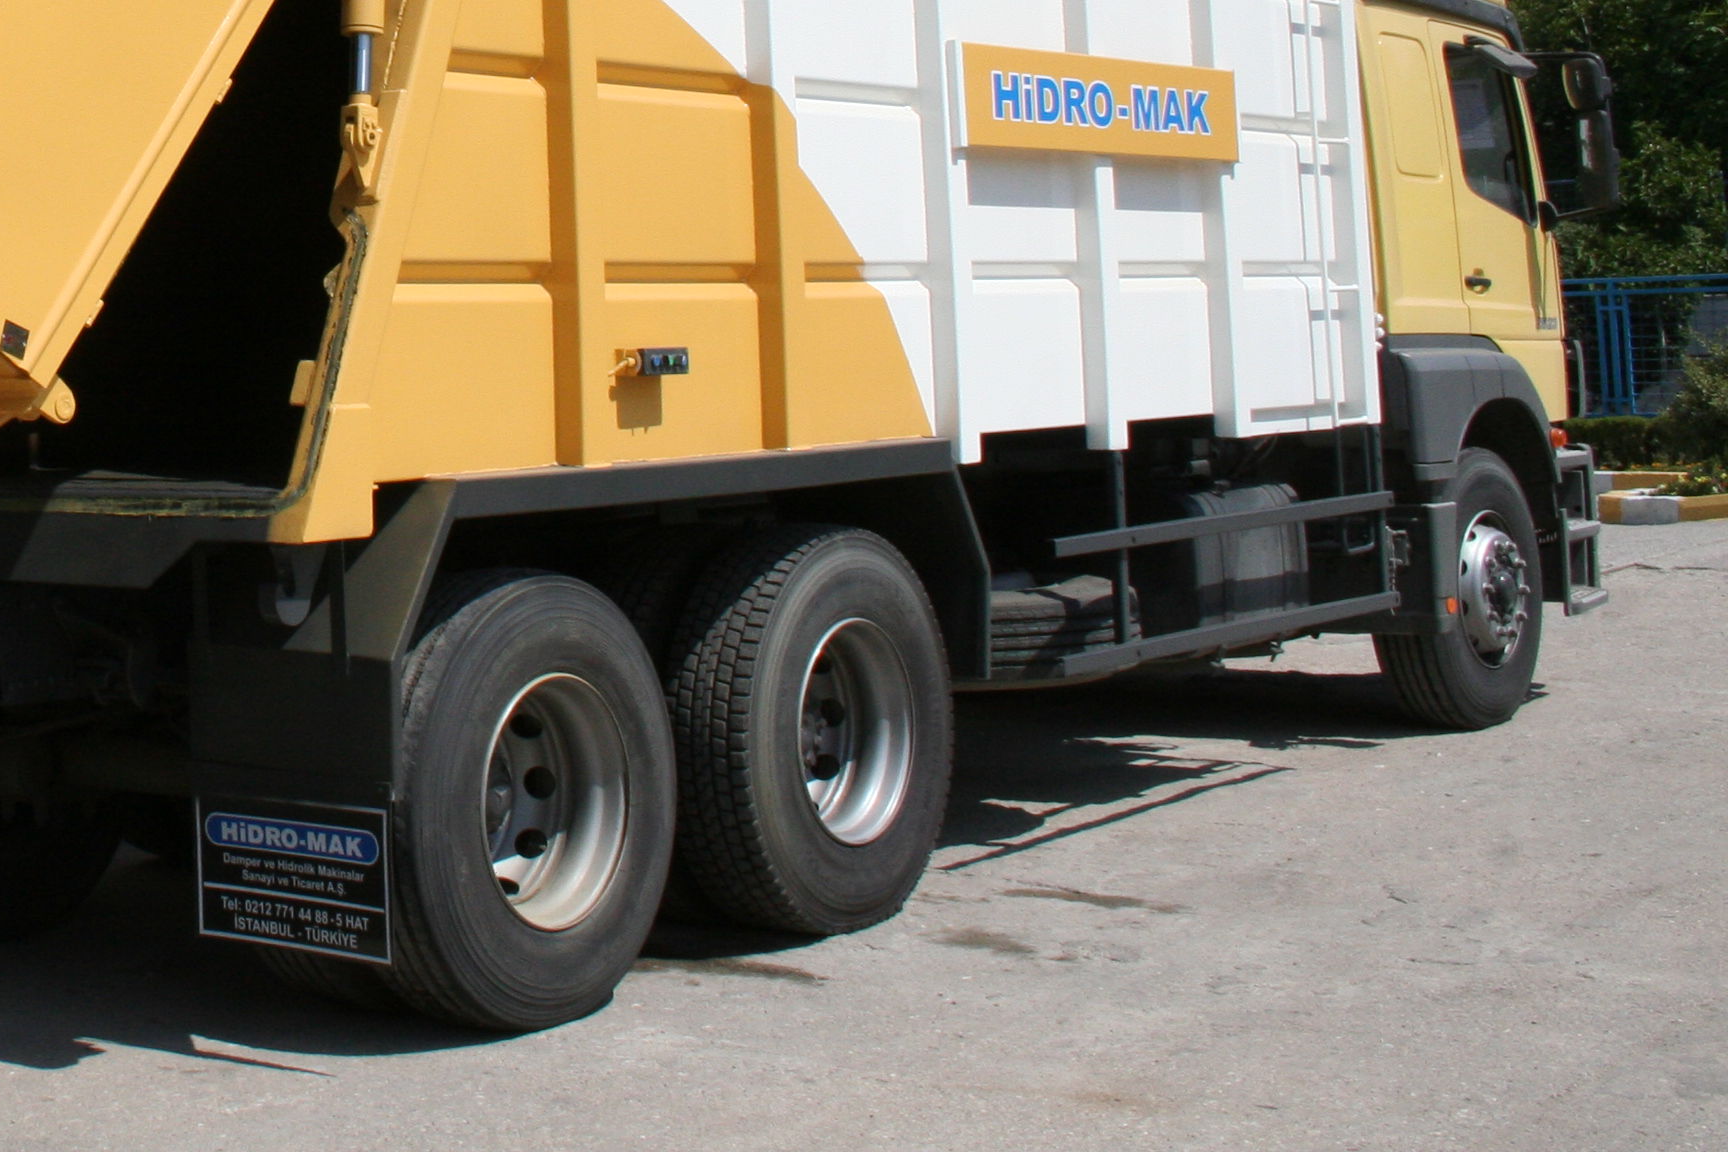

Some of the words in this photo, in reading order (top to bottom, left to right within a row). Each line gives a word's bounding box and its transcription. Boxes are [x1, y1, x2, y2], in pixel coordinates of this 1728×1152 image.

[992, 70, 1211, 135] HiDRO-MAK
[220, 820, 364, 858] HiDRO-MAK
[222, 852, 261, 868] Damper
[263, 859, 276, 870] ve
[277, 859, 315, 874] Hidrolik
[317, 865, 365, 882] Makinalar
[241, 869, 275, 886] Sanayi
[276, 876, 289, 886] ve
[291, 876, 325, 892] Ticaret
[326, 881, 348, 897] A.Ş.
[220, 895, 242, 910] Tel:
[244, 899, 273, 916] 0212
[274, 903, 295, 919] 771
[298, 907, 312, 922] 44
[345, 914, 369, 932] HAT
[233, 912, 295, 938] İSTANBUL
[304, 925, 359, 949] TÜRKİYE
